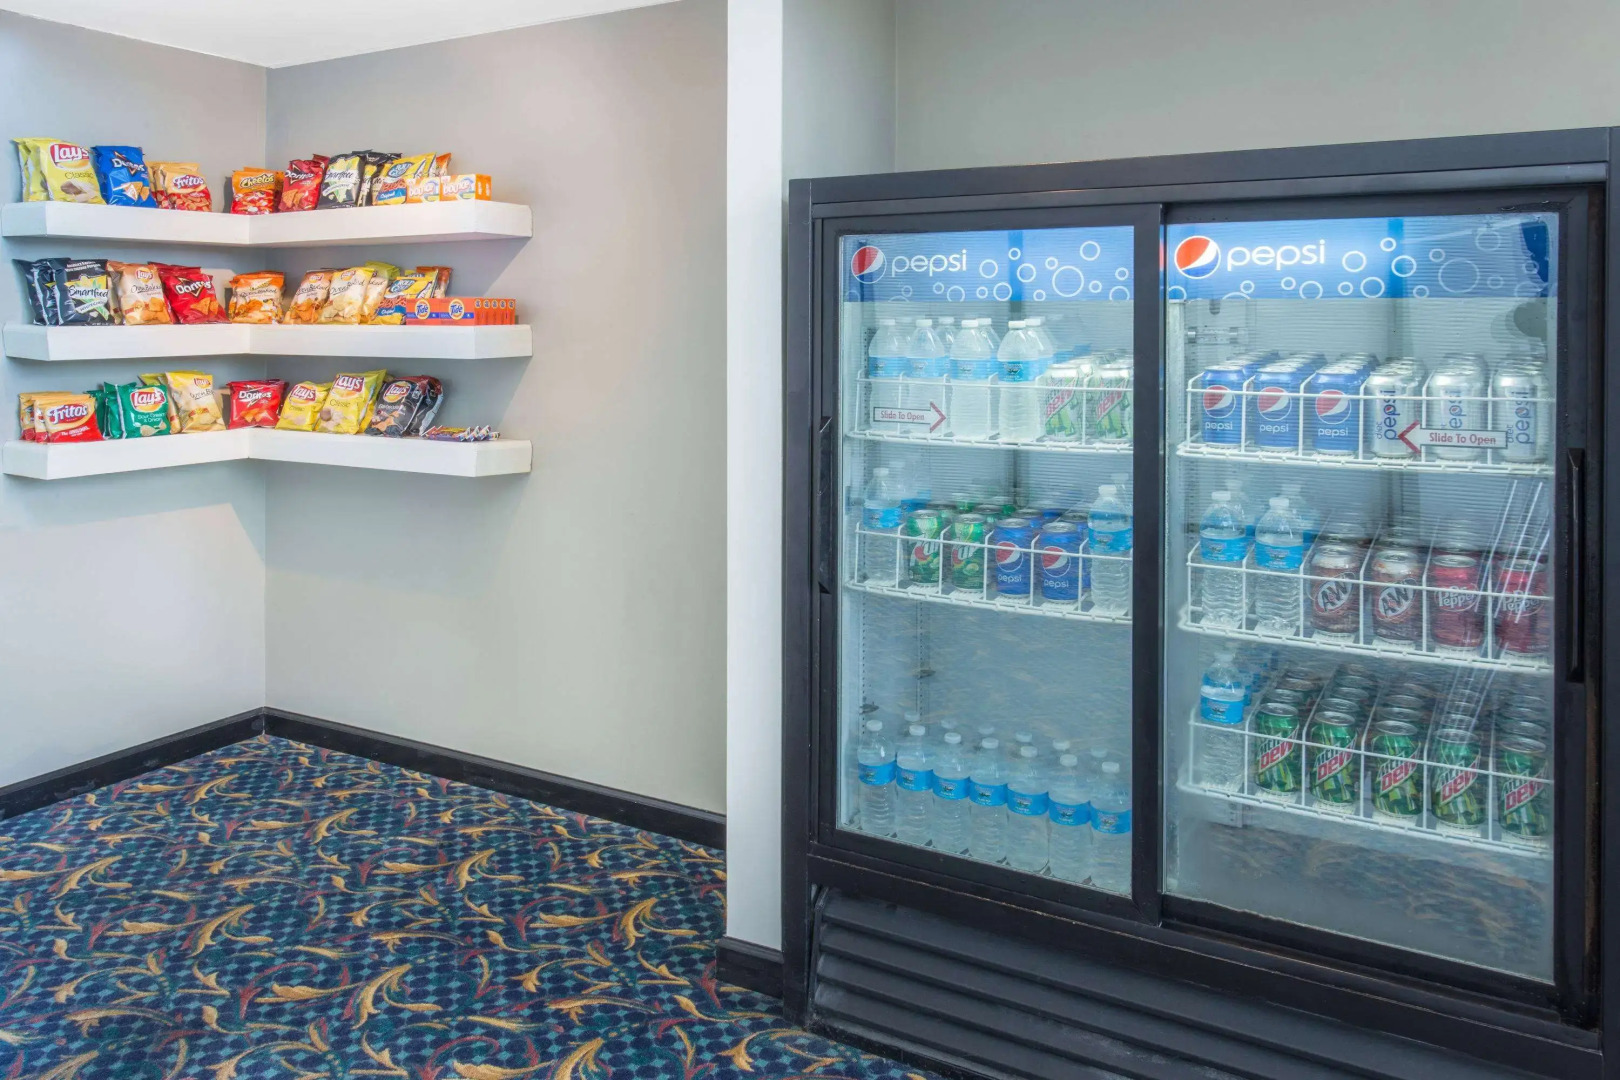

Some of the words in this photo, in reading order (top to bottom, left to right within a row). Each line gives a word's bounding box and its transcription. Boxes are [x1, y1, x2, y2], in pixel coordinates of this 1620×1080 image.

[173, 174, 205, 190] Fritos
[240, 173, 275, 188] Cheetos
[1227, 239, 1326, 272] pepsi
[891, 248, 967, 278] pepsi
[175, 280, 212, 295] Doritos
[416, 303, 429, 315] Tide
[450, 303, 463, 315] Tide
[239, 390, 272, 400] Doritos
[46, 405, 88, 424] Fritos
[880, 411, 896, 421] Slide
[898, 411, 905, 420] To
[906, 412, 925, 422] Open
[1205, 421, 1233, 431] pepsi
[1259, 424, 1289, 434] pepsi
[1317, 427, 1349, 438] pepsi
[1429, 432, 1453, 443] Slide
[1455, 433, 1467, 444] To
[1469, 434, 1497, 446] Open
[997, 573, 1022, 584] pepsi
[1043, 579, 1069, 589] pepsi
